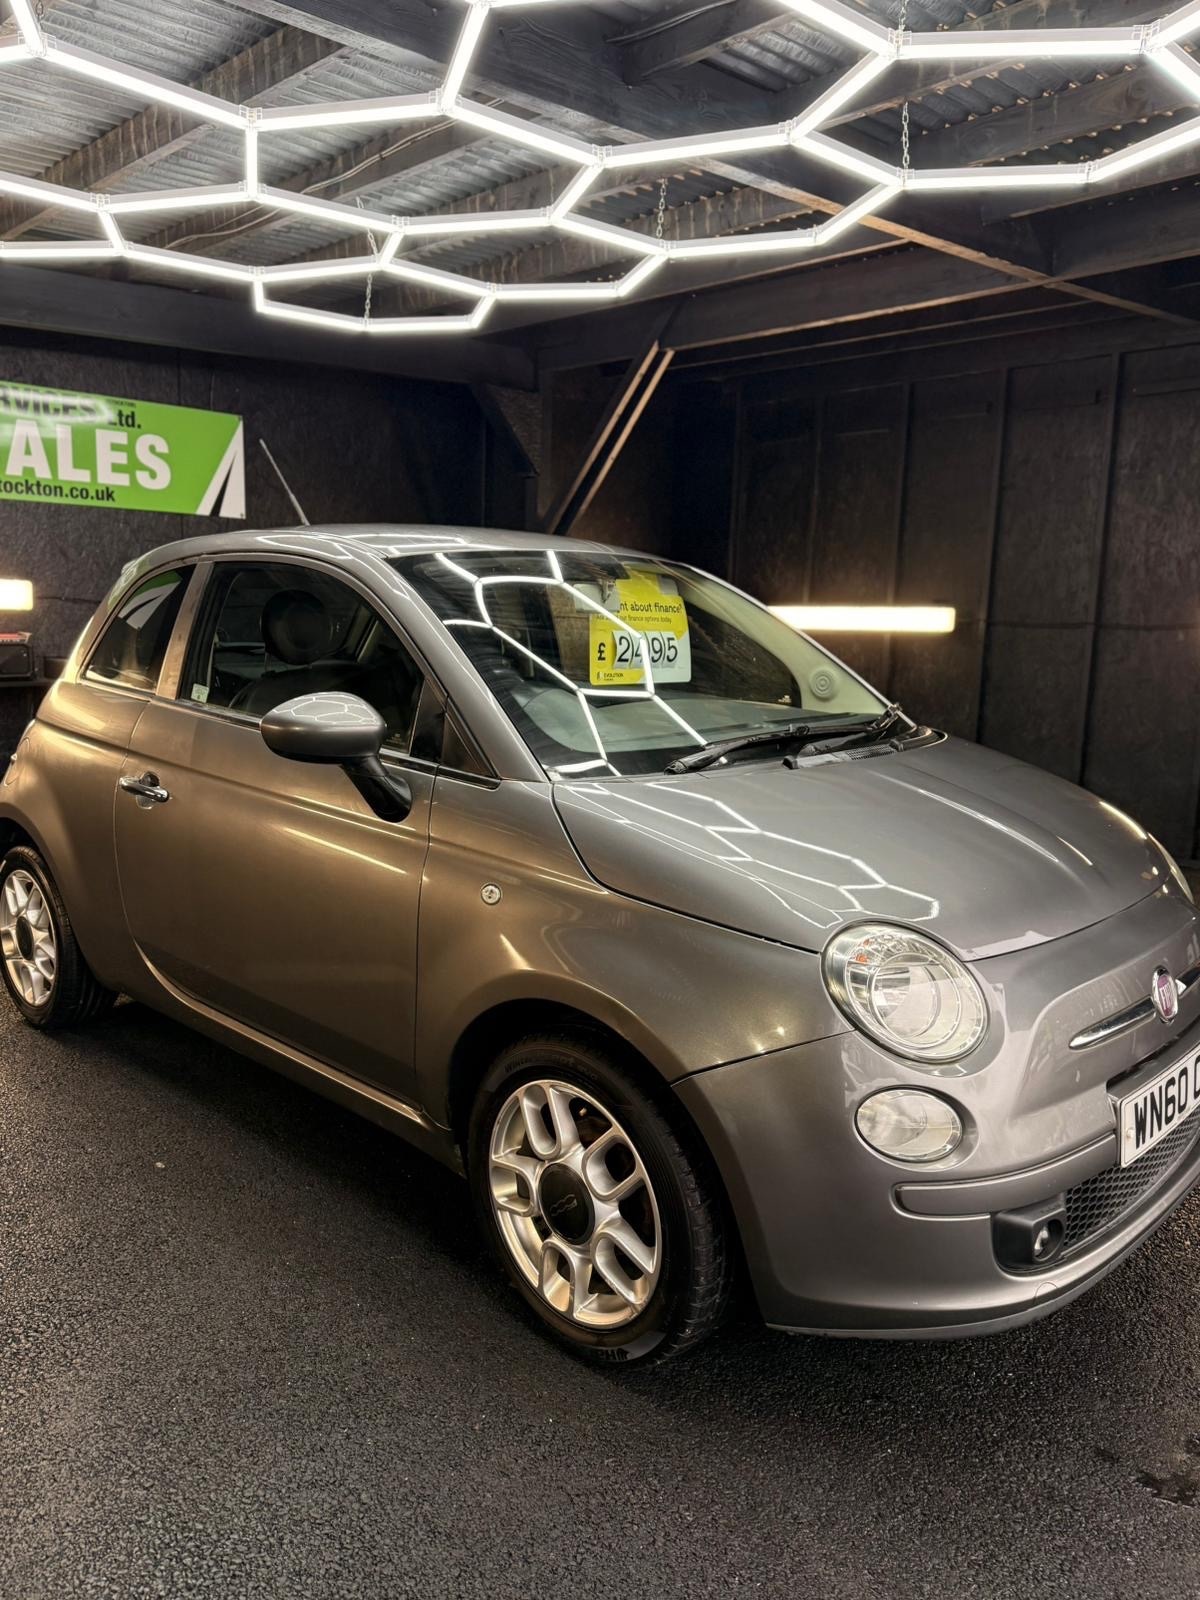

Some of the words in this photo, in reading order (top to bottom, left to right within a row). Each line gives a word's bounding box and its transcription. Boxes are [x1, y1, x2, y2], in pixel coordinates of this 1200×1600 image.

[5, 418, 172, 490] ALES
[630, 601, 652, 613] about
[597, 642, 606, 661] £
[1134, 1066, 1188, 1150] WN60
